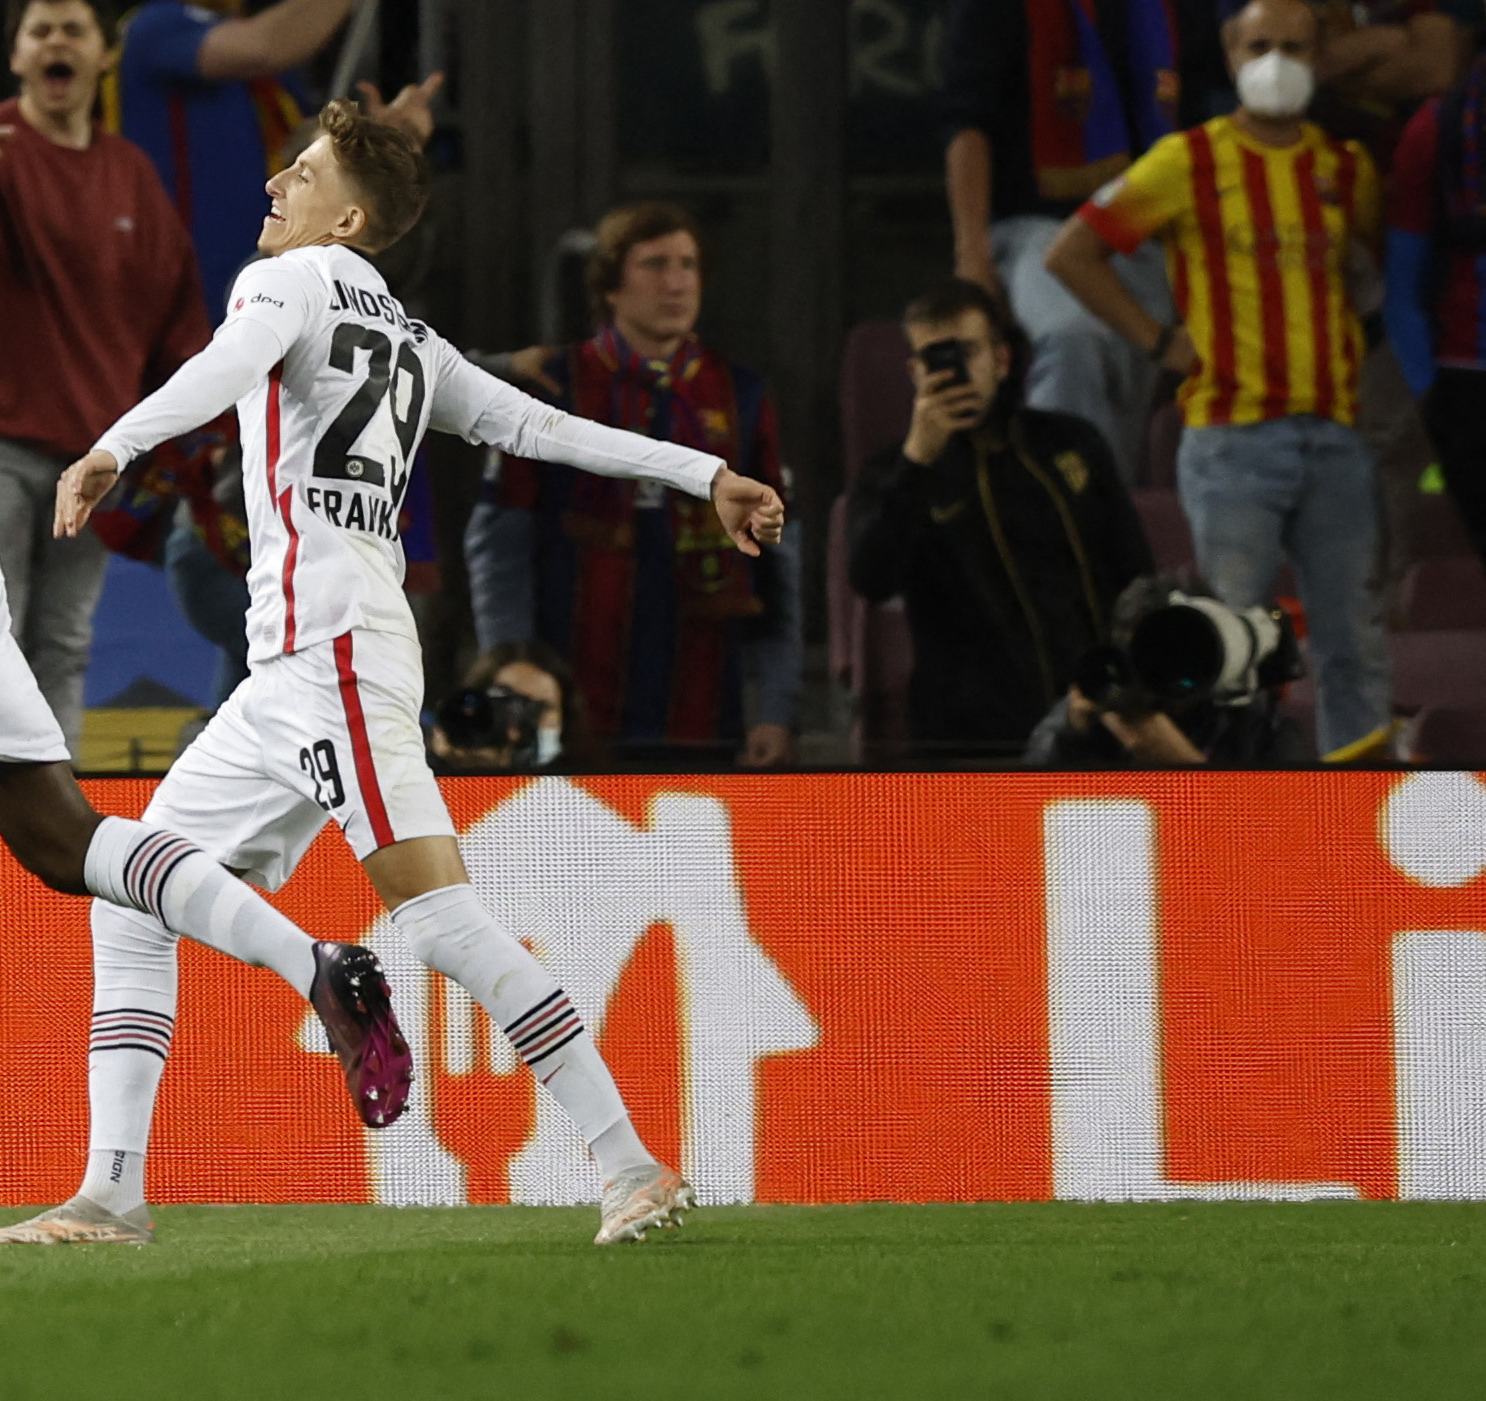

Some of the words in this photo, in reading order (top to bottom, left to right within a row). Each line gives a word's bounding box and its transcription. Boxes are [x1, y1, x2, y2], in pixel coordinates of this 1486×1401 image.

[312, 322, 426, 508] 29
[307, 487, 399, 542] FRANK
[299, 738, 346, 811] 29
